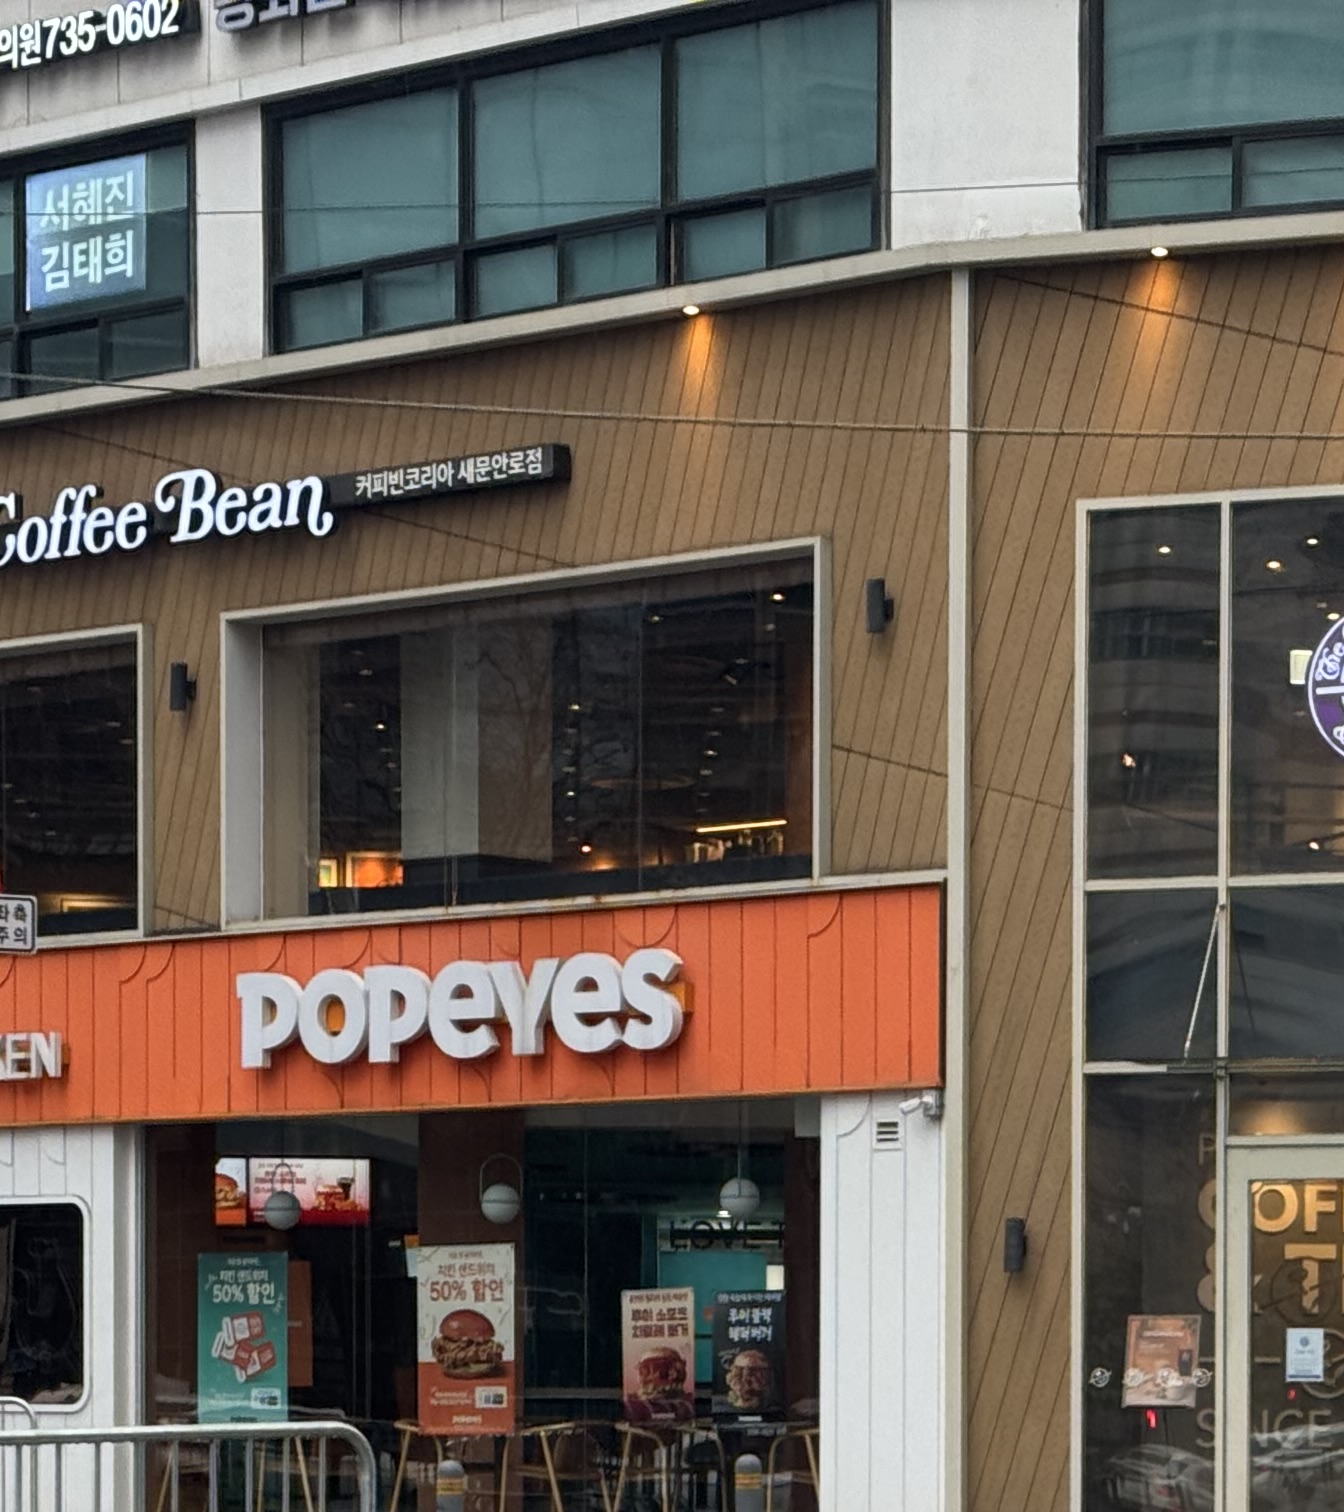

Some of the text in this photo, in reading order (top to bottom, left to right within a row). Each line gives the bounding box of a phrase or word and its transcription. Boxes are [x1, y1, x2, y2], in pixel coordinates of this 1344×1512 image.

[42, 0, 179, 56] 735-0602
[40, 170, 135, 231] 서혜진
[40, 230, 134, 292] 김태희
[355, 447, 543, 499] 커피빈코리아 새문안로점
[154, 467, 334, 545] Bean
[213, 1282, 275, 1305] 50% 할인
[430, 1278, 504, 1303] 50% 할인
